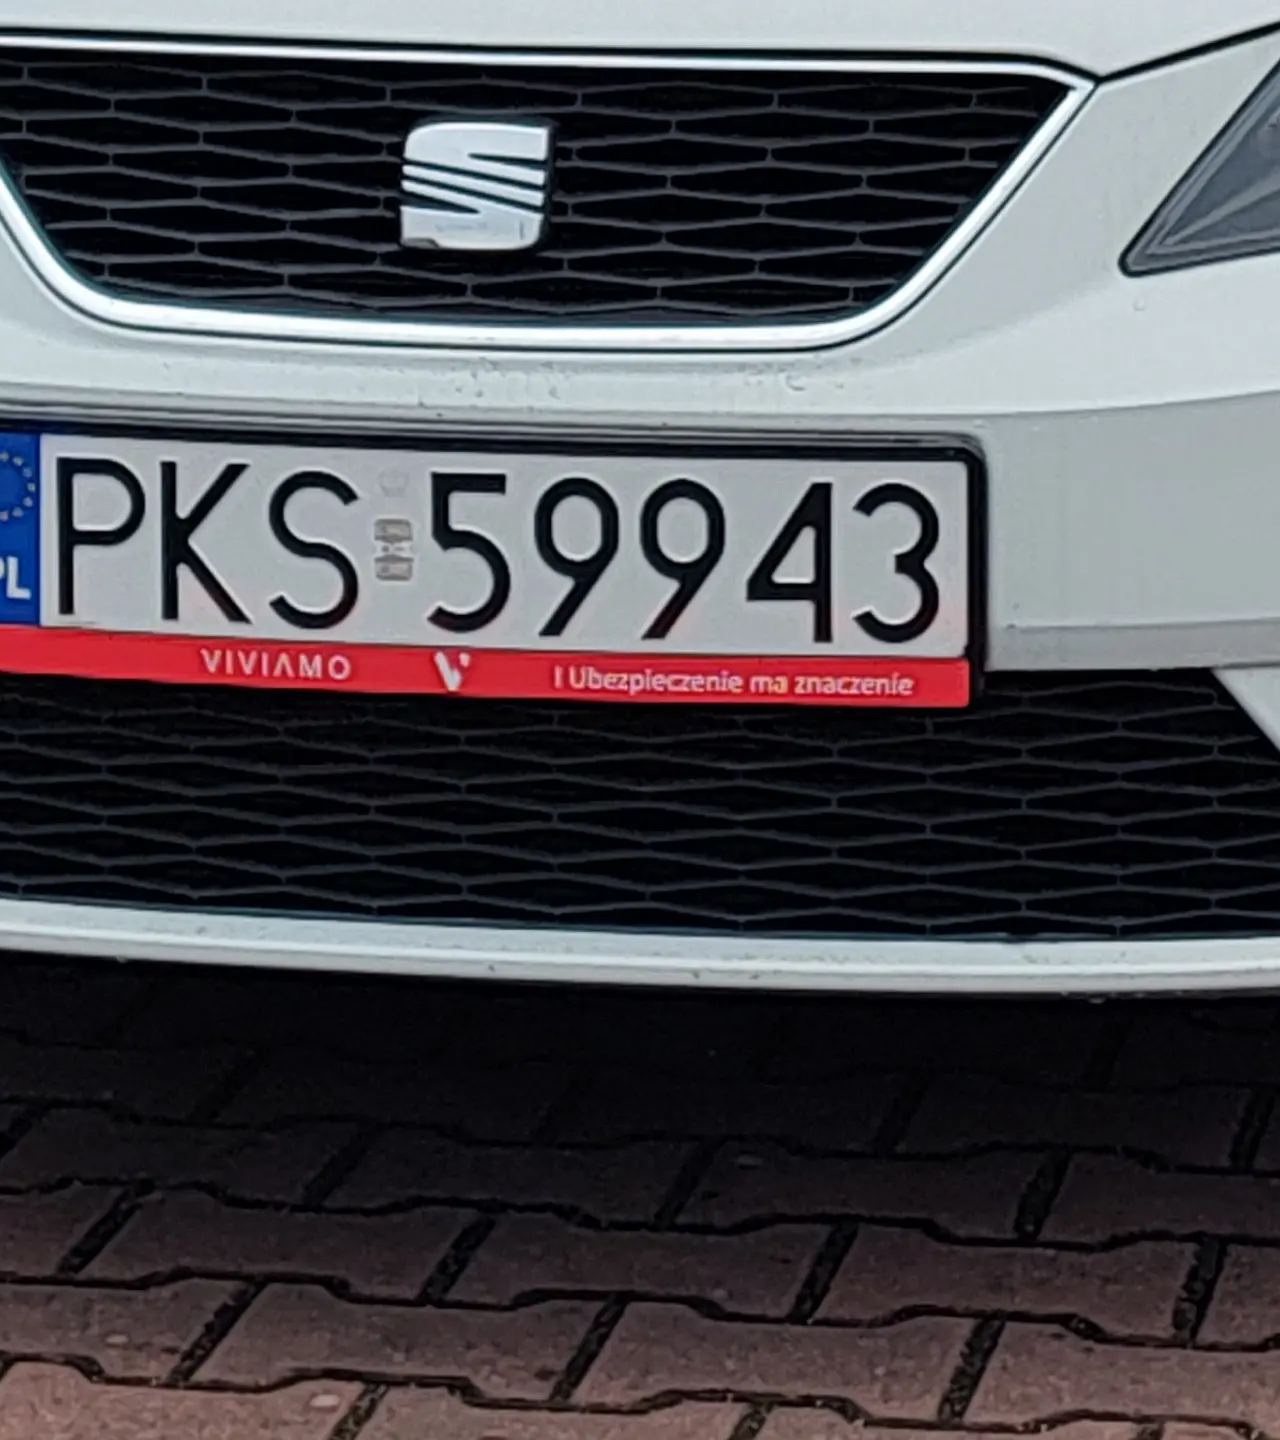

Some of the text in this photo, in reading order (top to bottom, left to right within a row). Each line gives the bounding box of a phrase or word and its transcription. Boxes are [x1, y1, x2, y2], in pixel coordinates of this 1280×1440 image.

[56, 456, 941, 643] PKS 59943
[200, 647, 352, 680] VIVIAMO
[569, 665, 742, 694] Ubezpieczenie
[750, 673, 788, 694] ma
[794, 671, 914, 696] znaczenie
